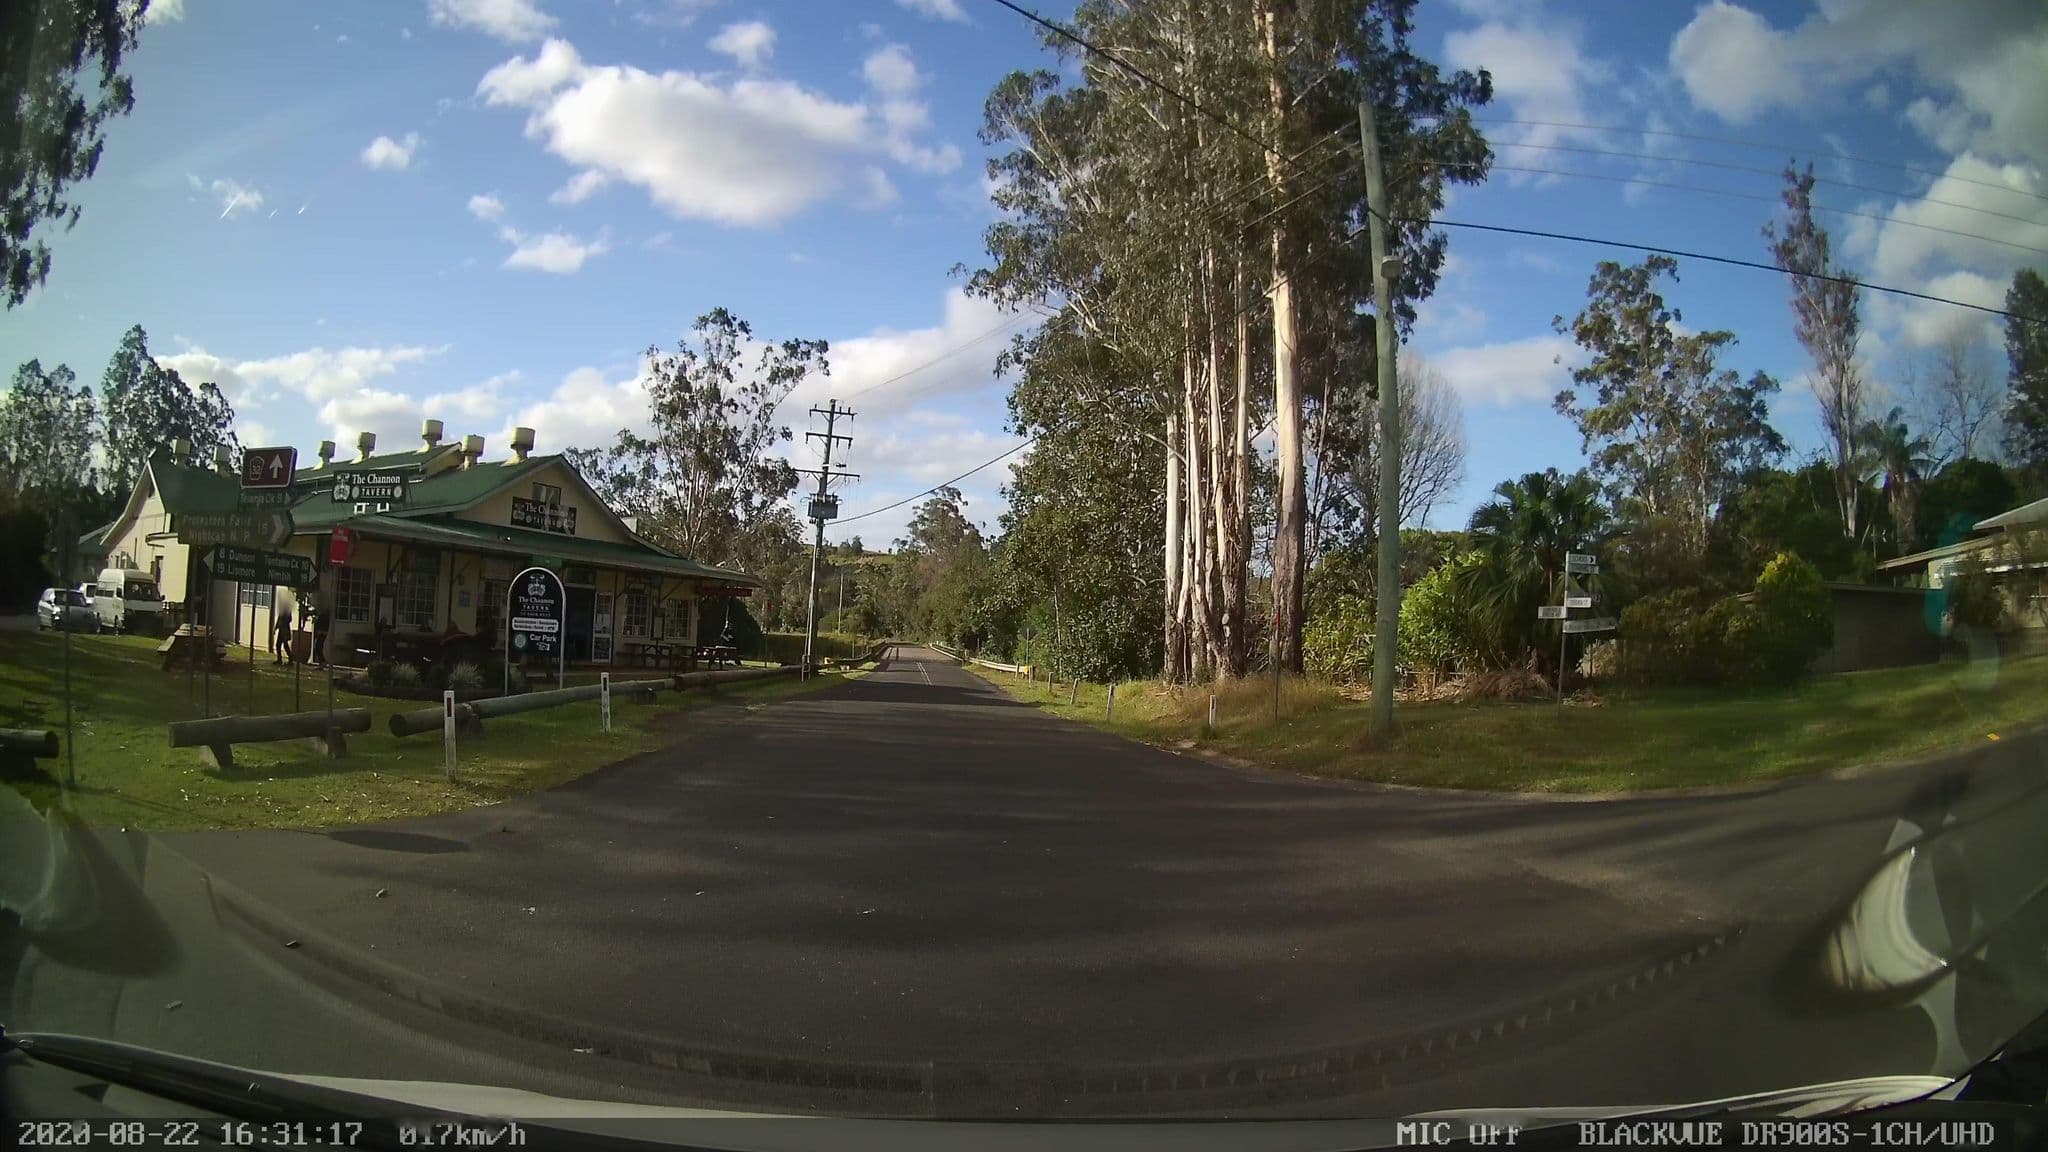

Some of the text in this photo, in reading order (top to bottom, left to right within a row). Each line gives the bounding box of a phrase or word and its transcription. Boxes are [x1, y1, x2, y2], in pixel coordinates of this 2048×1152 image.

[352, 473, 401, 484] The Channon
[361, 488, 391, 496] TAVERN
[525, 502, 537, 513] The
[219, 547, 226, 559] 8
[217, 563, 257, 577] 19 Lismore
[519, 596, 555, 605] The Channon
[529, 633, 558, 644] Car Park
